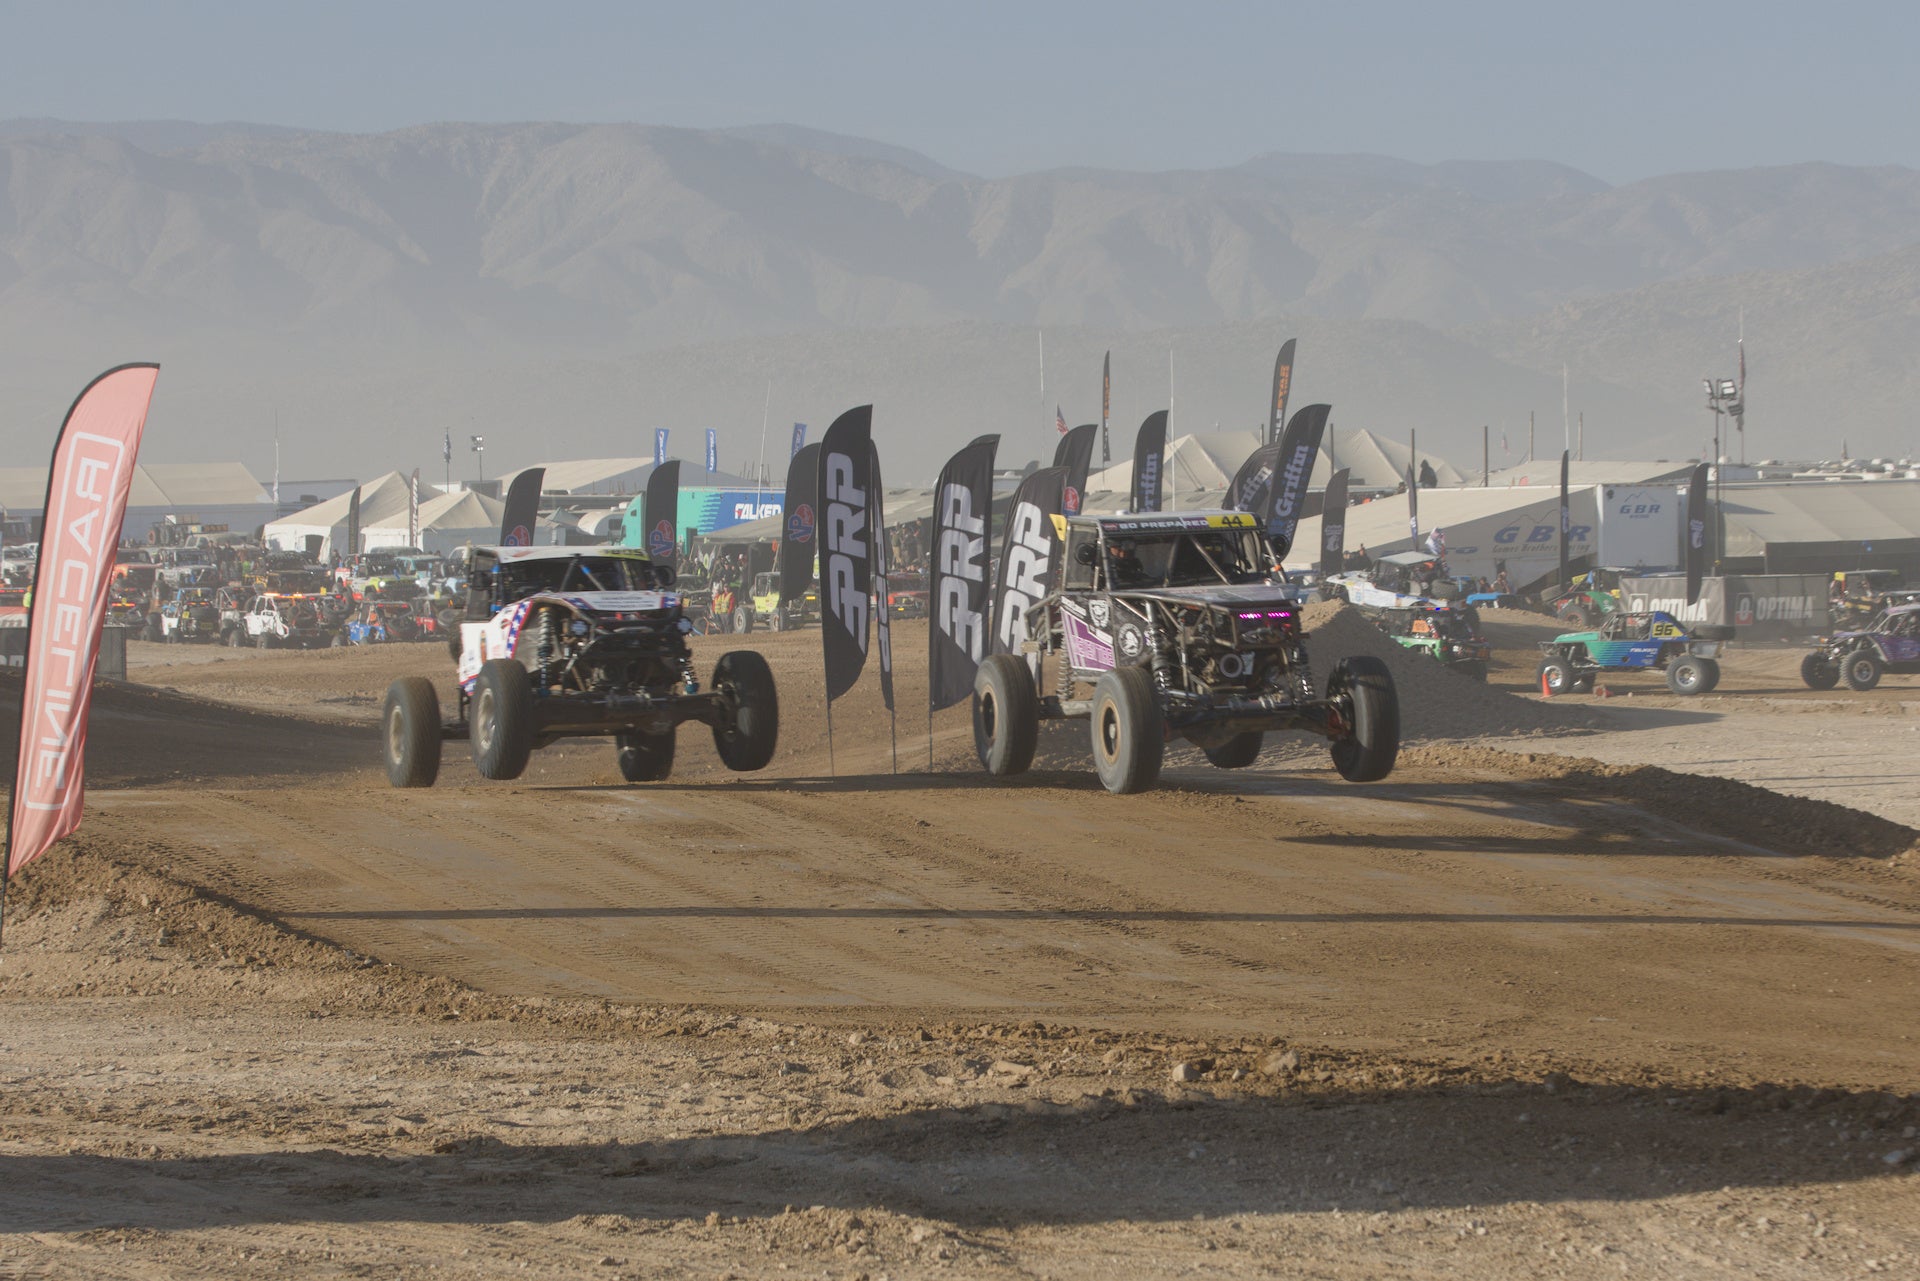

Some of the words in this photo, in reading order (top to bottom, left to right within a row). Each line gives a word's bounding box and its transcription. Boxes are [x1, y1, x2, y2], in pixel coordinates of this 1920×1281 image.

[1237, 466, 1273, 511] riffin
[1275, 444, 1310, 517] Griffin
[1619, 503, 1661, 514] GBR
[1140, 519, 1209, 529] PREPARED
[1221, 515, 1243, 528] 44
[1493, 525, 1592, 544] GBR
[826, 452, 867, 655] PRP
[939, 482, 984, 666] PRP
[1755, 595, 1814, 620] OPTIMA
[1653, 625, 1673, 636] 96
